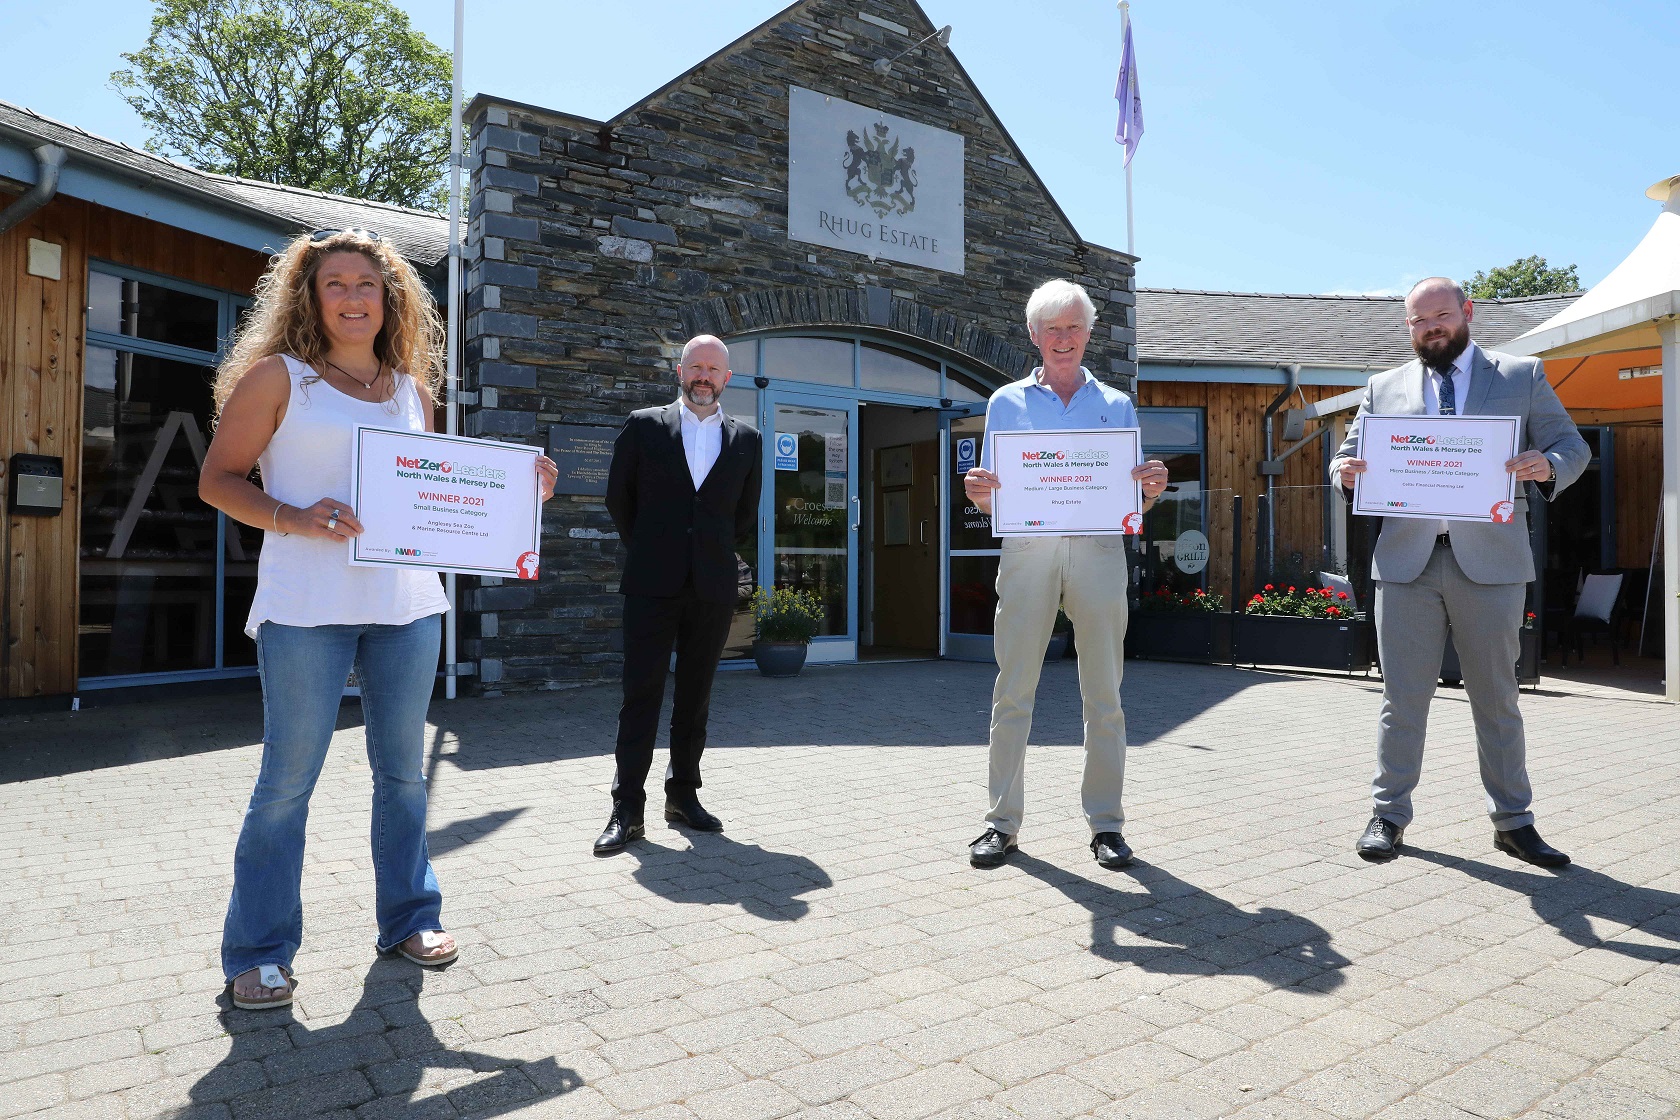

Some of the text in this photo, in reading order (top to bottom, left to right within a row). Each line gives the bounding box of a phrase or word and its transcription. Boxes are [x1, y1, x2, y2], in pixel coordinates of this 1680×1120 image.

[820, 210, 938, 253] RHUG ESTATE
[1391, 435, 1484, 446] NetZero Leaders
[1022, 449, 1109, 460] NetZero Leaders
[396, 456, 506, 480] NetZero Leaders
[396, 470, 421, 480] North
[424, 474, 450, 483] Wales
[459, 478, 488, 488] Mersey
[490, 481, 505, 490] Dee
[418, 491, 484, 506] WINNER 2021
[432, 506, 458, 514] Business
[460, 509, 488, 517] Category
[794, 514, 832, 526] Welcome
[395, 548, 422, 557] NWMD
